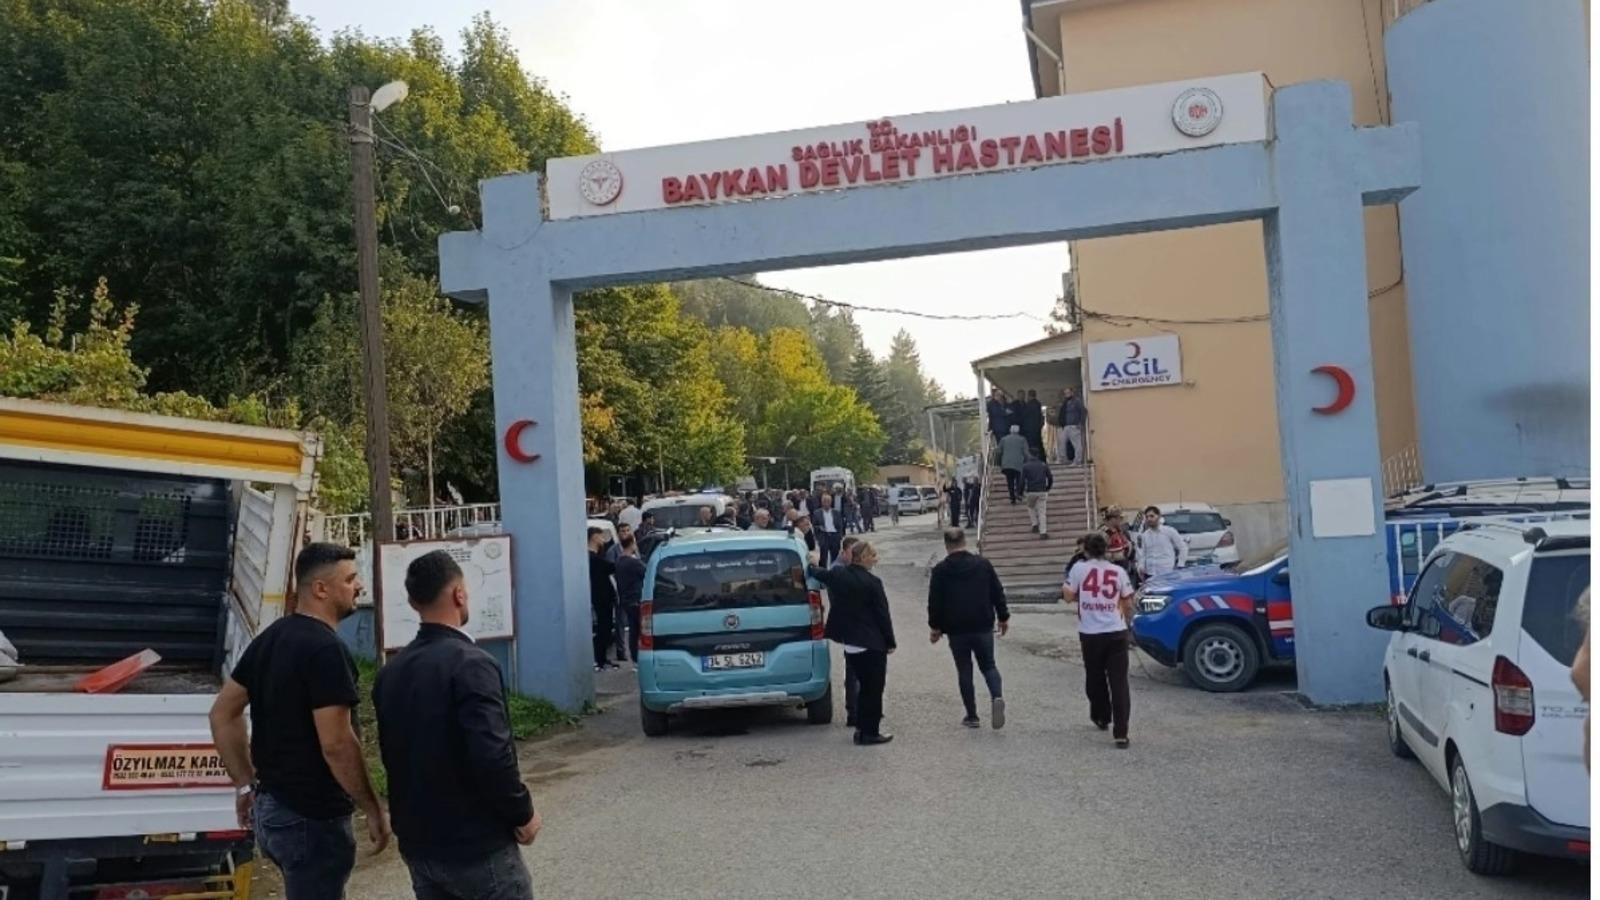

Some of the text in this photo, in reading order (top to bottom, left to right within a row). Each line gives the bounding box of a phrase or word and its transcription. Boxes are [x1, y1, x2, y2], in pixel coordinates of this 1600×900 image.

[662, 164, 789, 204] BAYKAN
[800, 147, 921, 189] DEVLET
[933, 117, 1124, 174] HASTANESİ
[1082, 567, 1119, 600] 45
[113, 754, 186, 771] ÖZYILMAZ
